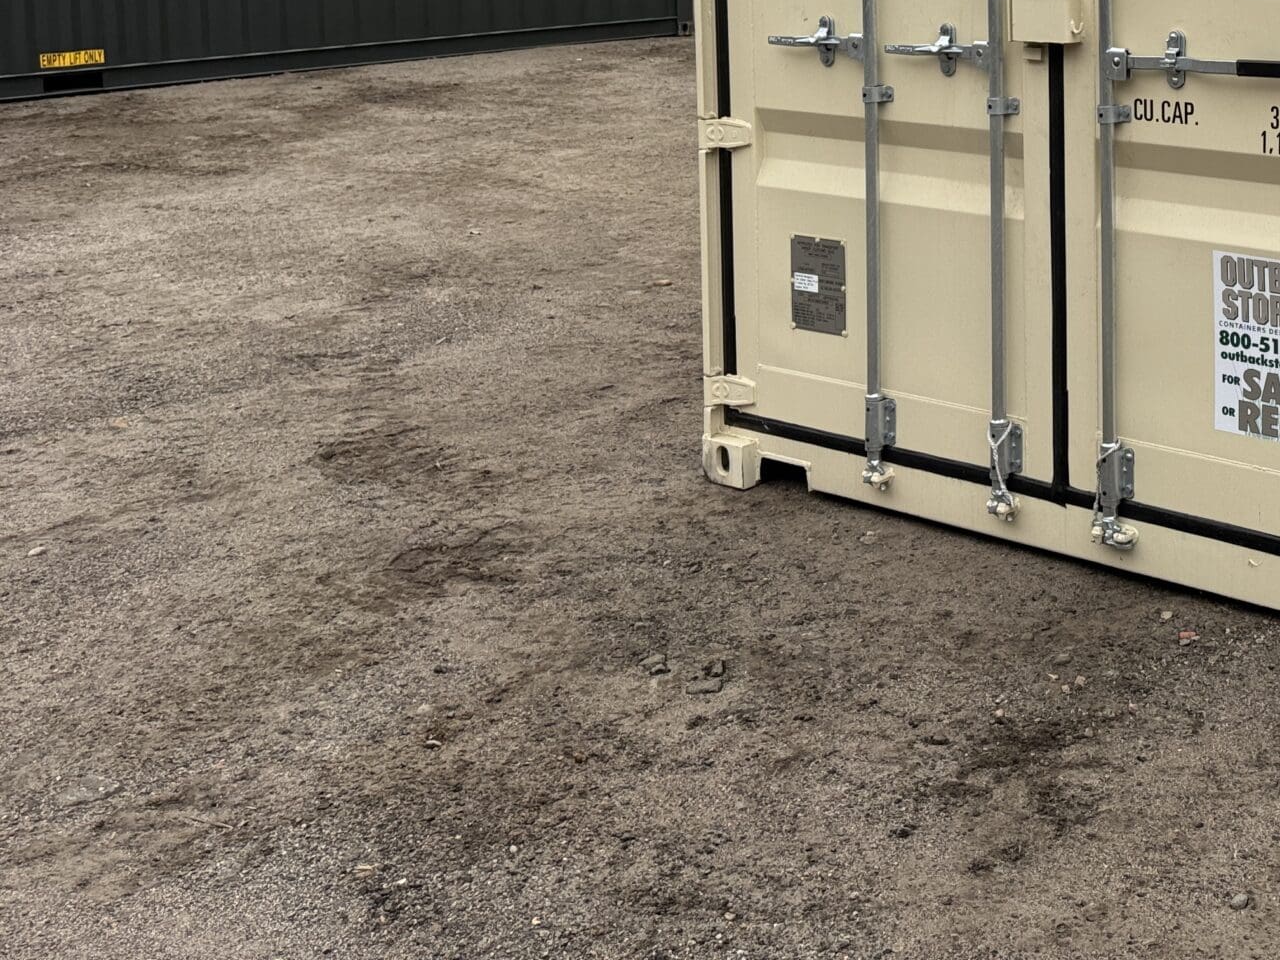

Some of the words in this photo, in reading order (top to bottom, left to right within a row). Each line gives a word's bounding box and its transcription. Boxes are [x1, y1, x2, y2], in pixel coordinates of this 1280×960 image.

[41, 53, 66, 67] EMPTY
[68, 52, 82, 65] LIFT
[83, 50, 103, 63] ONLY
[1133, 98, 1199, 126] CU.CAP.
[1219, 320, 1266, 333] CONTAINERS
[1222, 373, 1241, 386] FOR
[1221, 405, 1236, 418] OR
